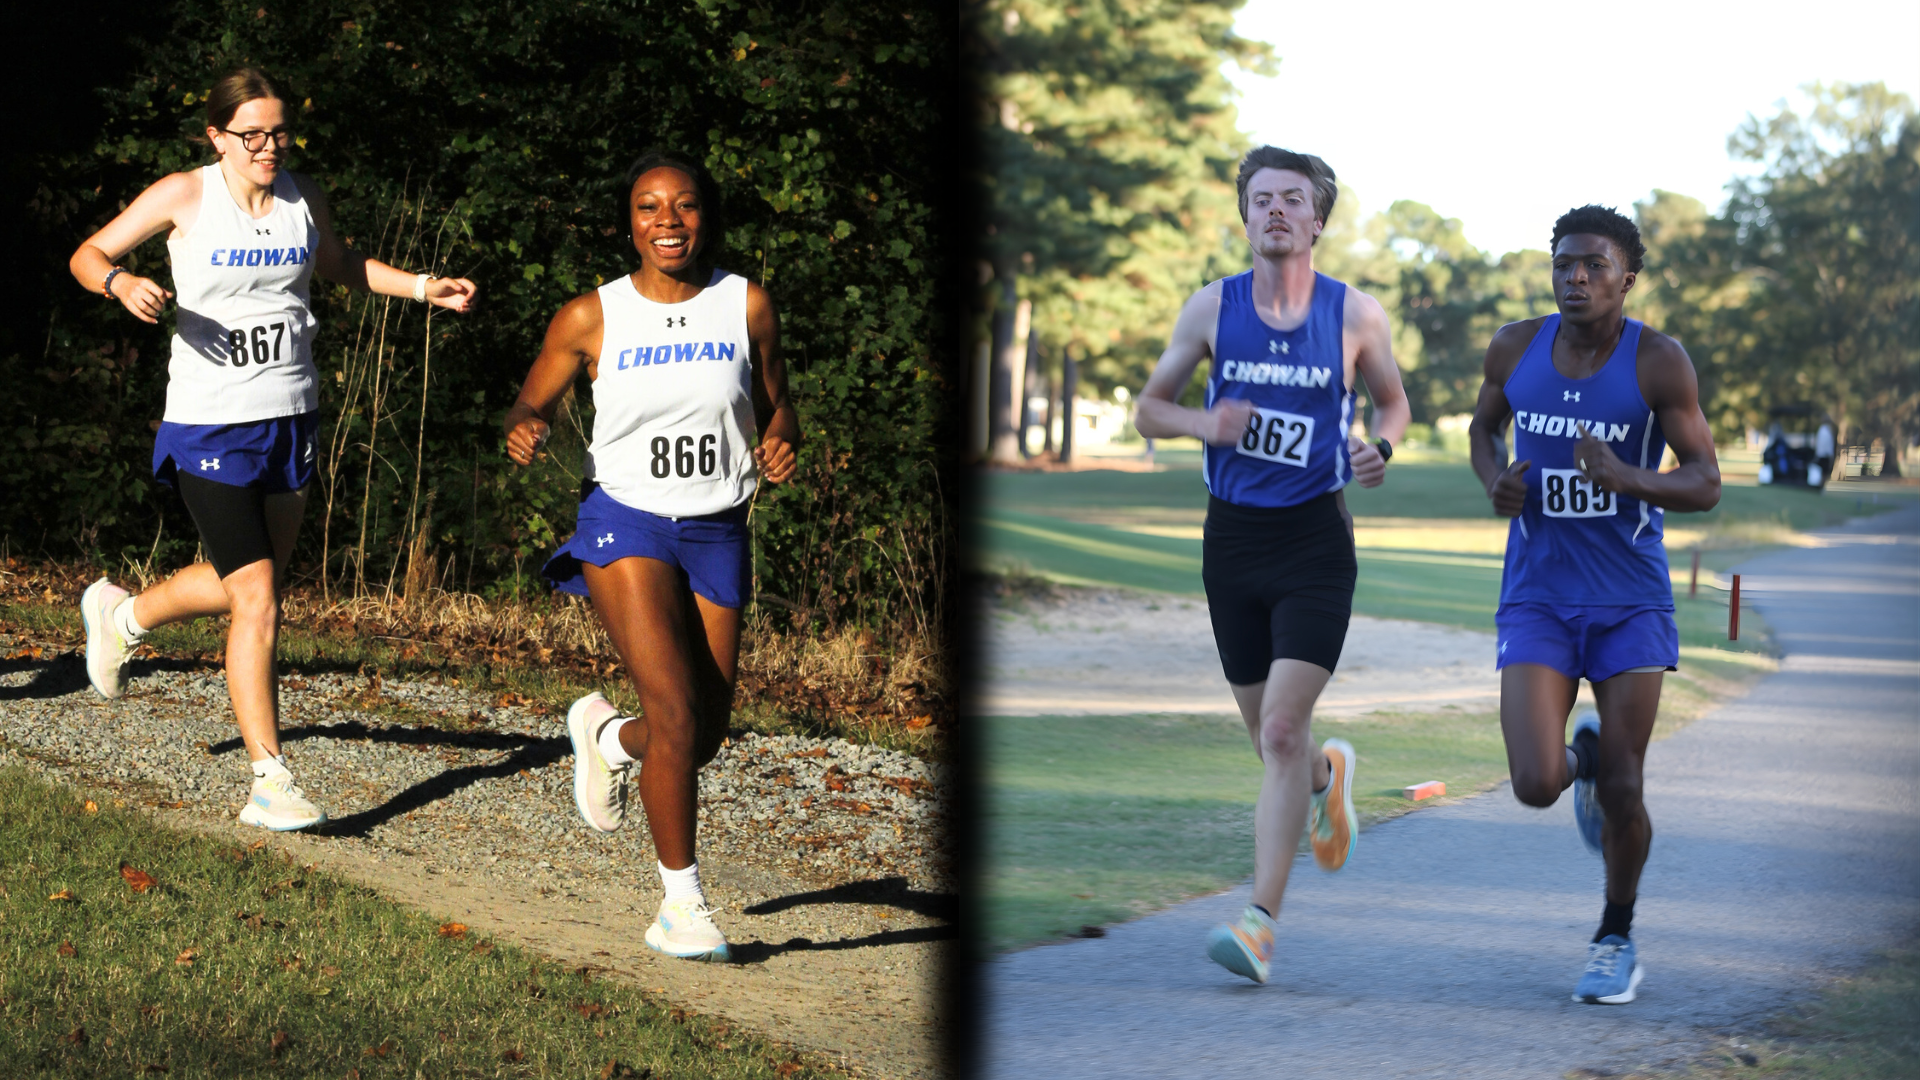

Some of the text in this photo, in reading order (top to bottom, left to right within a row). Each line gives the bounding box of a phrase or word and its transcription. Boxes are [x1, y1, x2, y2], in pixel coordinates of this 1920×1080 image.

[211, 246, 311, 267] CHOWAN
[229, 322, 285, 367] 867
[617, 342, 736, 371] CHOWAN
[1222, 359, 1332, 389] CHOWAN
[1242, 411, 1307, 461] 862
[1516, 410, 1631, 442] CHOWAN
[650, 434, 716, 479] 866
[1546, 474, 1611, 513] 865
